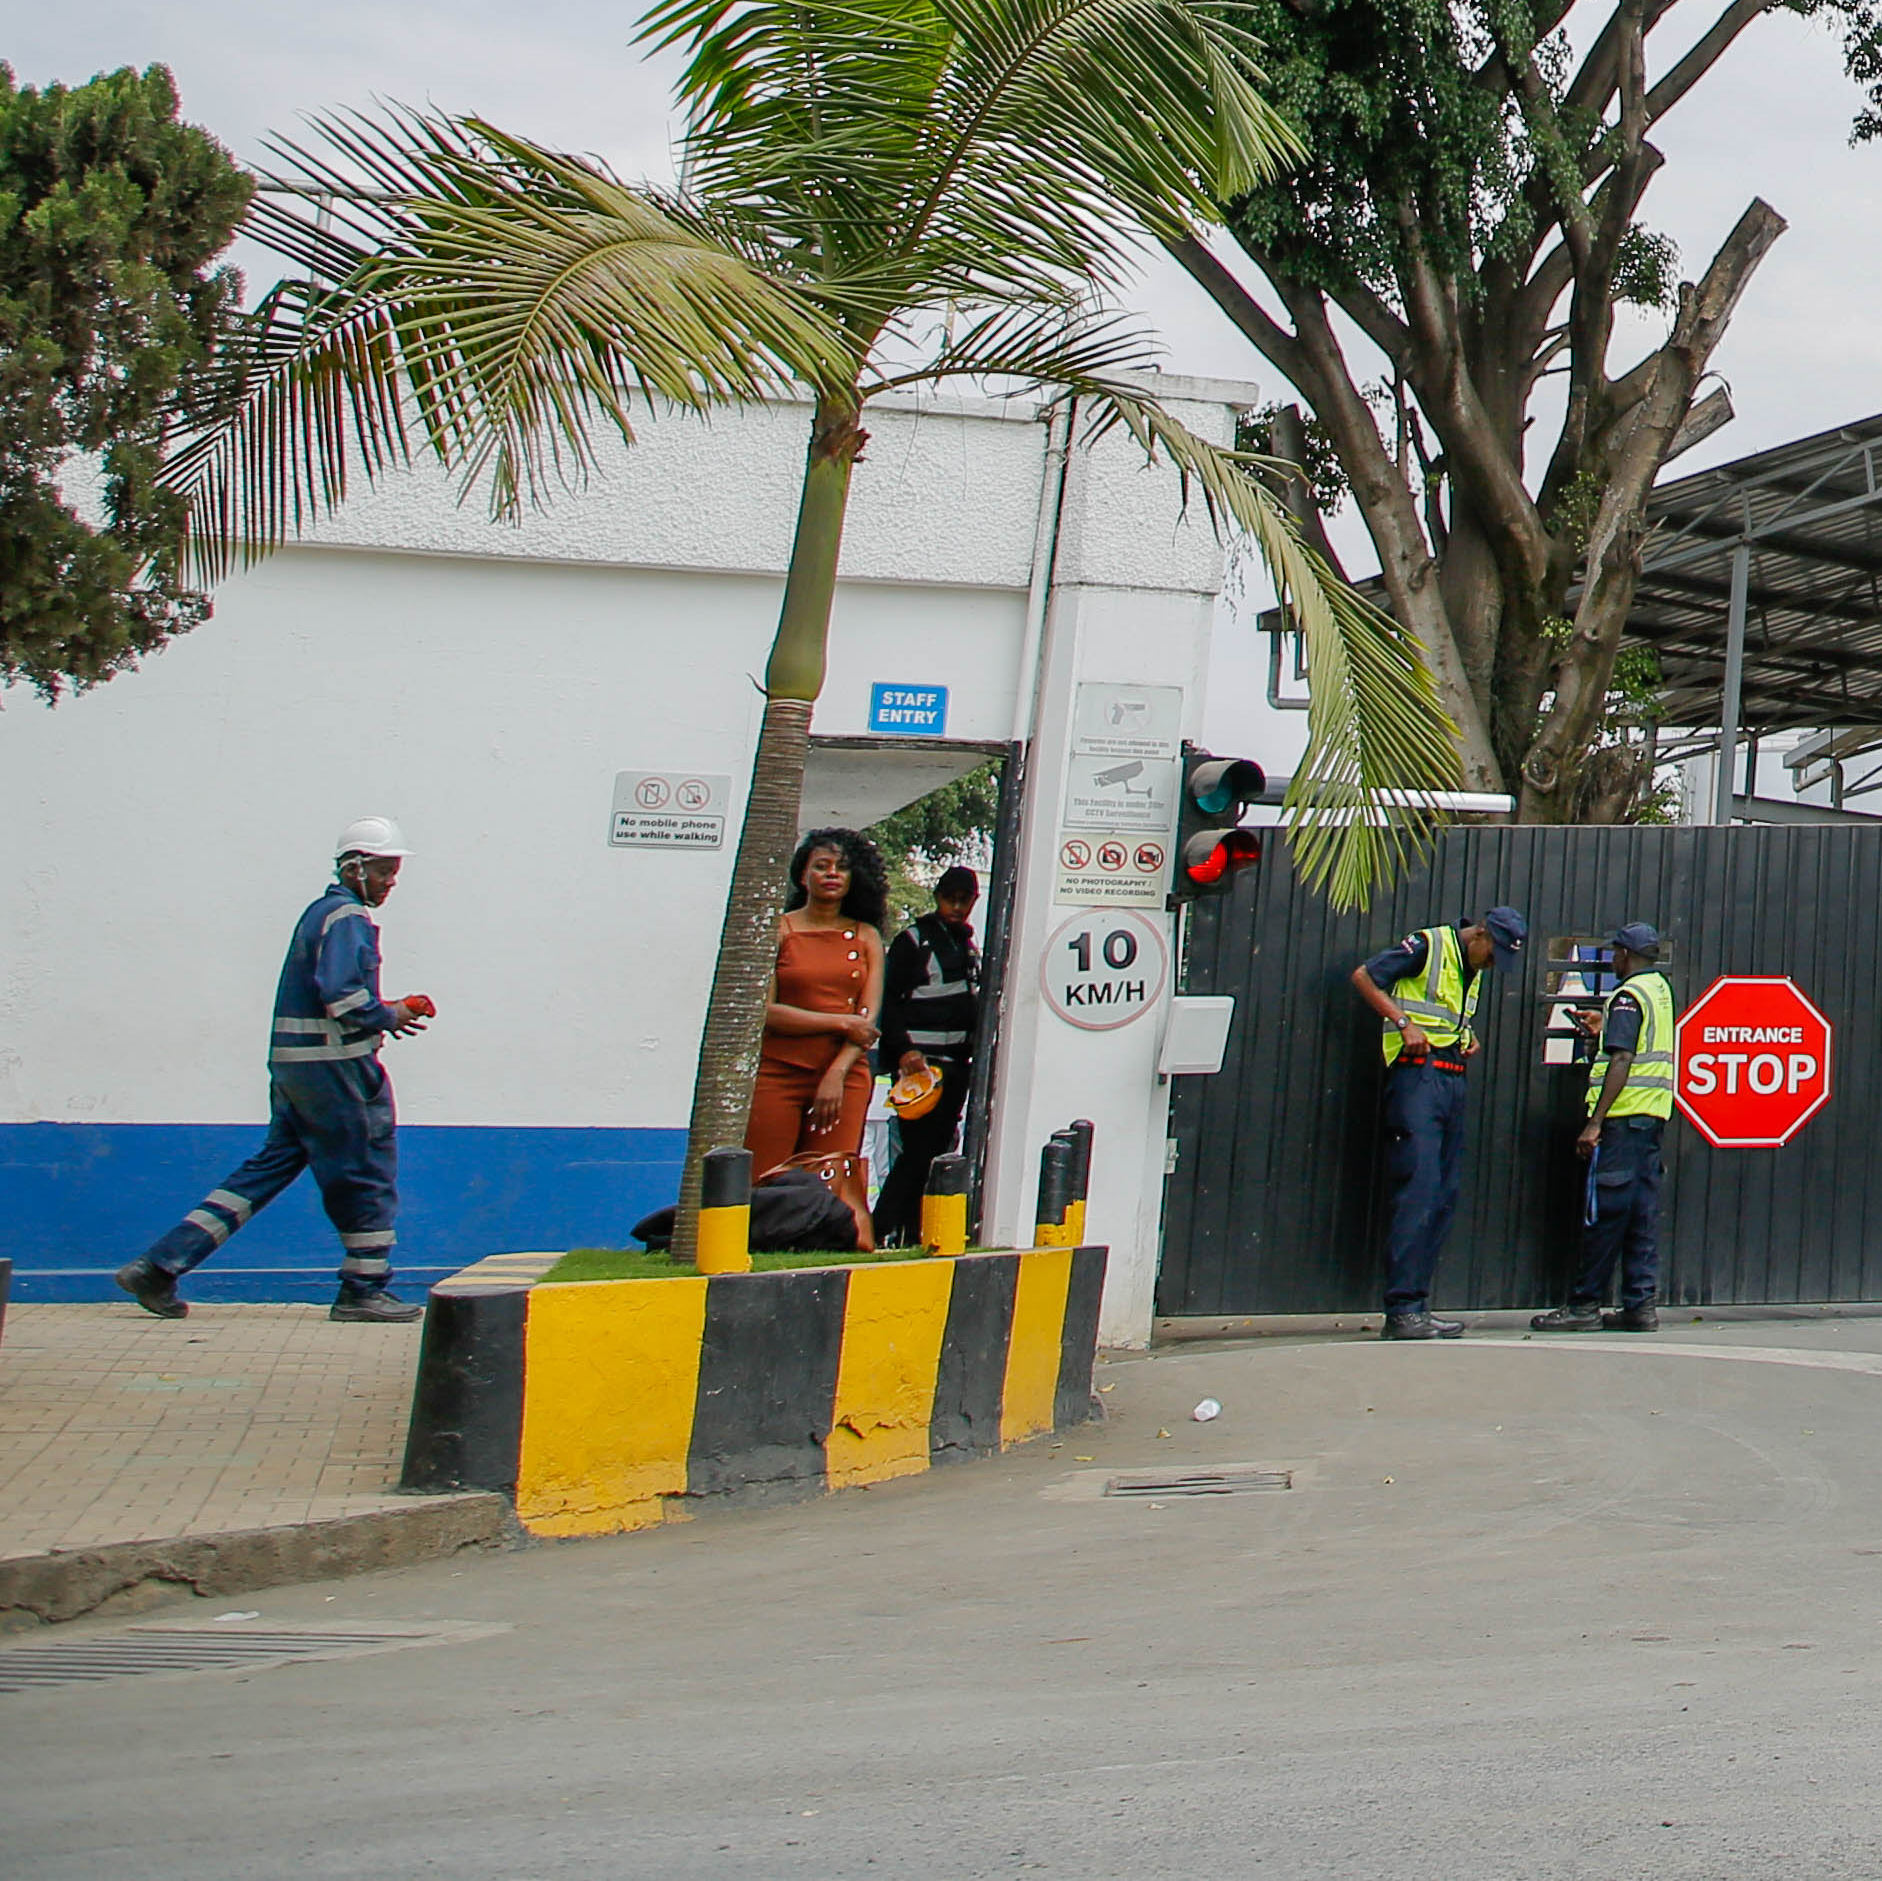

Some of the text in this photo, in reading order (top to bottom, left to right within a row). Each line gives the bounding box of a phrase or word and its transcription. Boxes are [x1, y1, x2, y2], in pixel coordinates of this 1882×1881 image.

[882, 691, 938, 707] STAFF
[878, 708, 938, 724] ENTRY
[620, 817, 717, 830] No mobile phone
[640, 831, 671, 839] while
[674, 832, 718, 843] walking
[1081, 878, 1147, 887] PHOTOGRAPHY
[1104, 888, 1156, 897] RECORDING
[1068, 929, 1138, 972] 10
[1066, 979, 1144, 1006] KM/H
[1703, 1026, 1803, 1044] ENTRANCE
[1686, 1053, 1817, 1095] STOP
